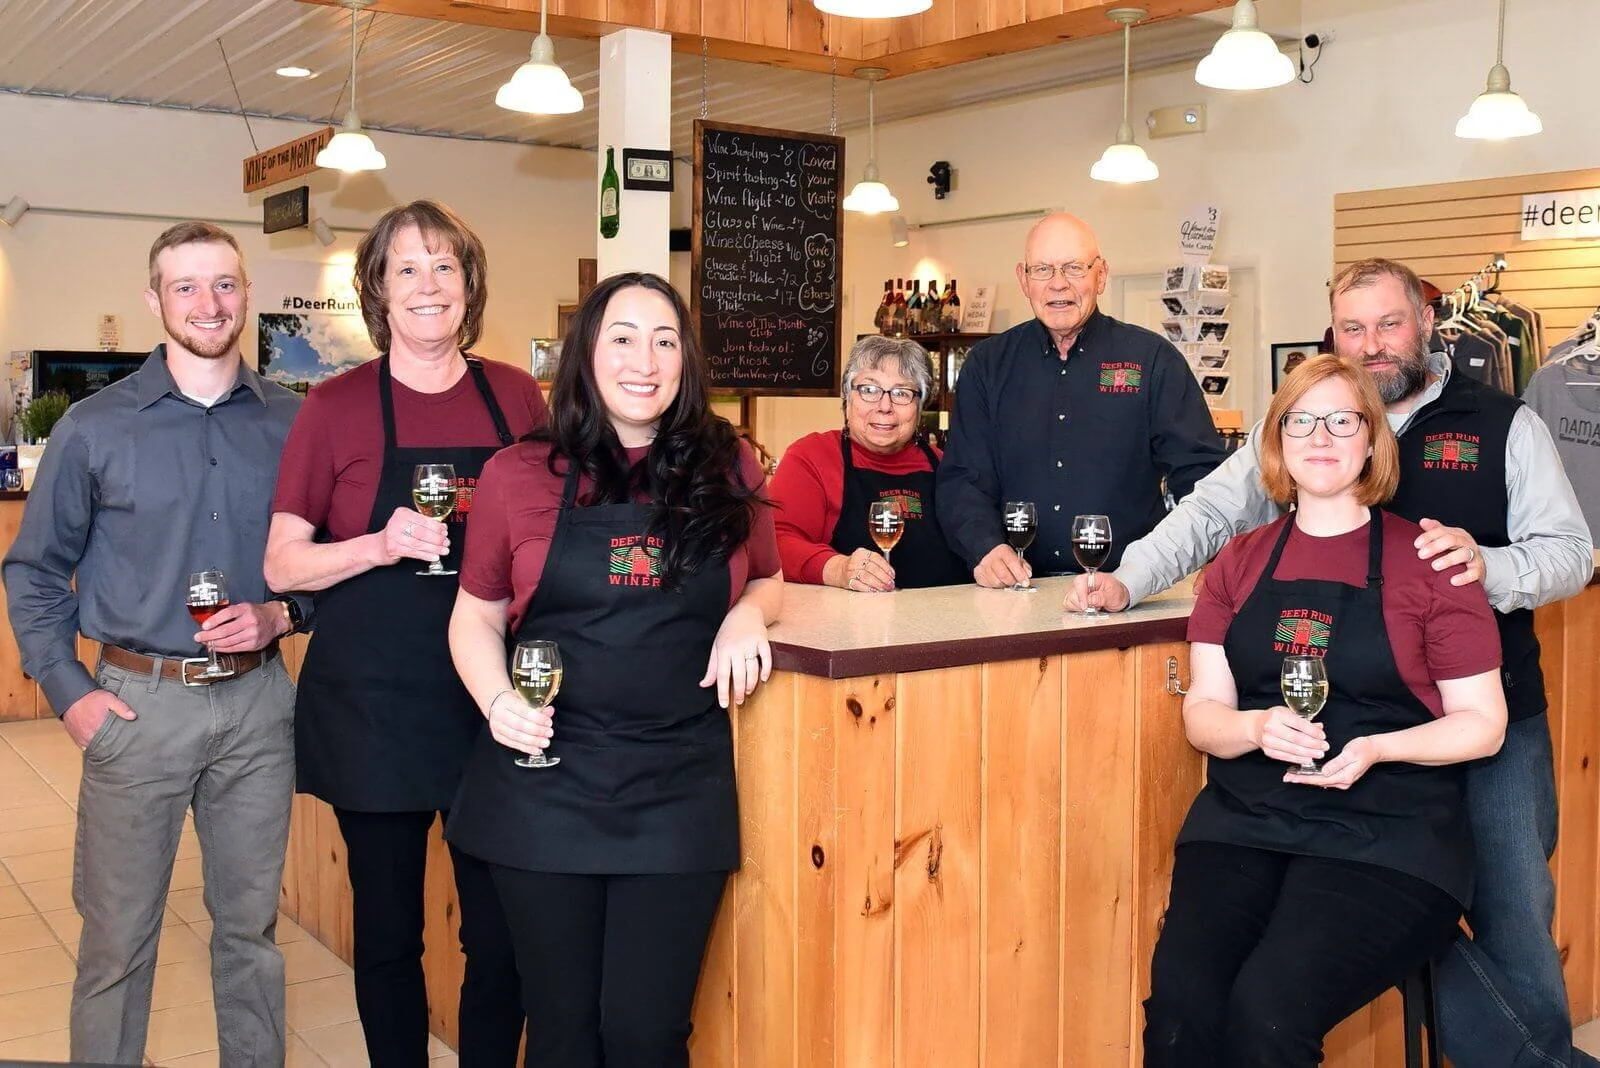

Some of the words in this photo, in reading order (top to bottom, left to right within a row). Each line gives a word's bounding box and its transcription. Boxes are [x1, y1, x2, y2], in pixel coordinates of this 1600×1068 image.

[277, 150, 290, 166] THE
[290, 134, 325, 173] MONTH
[704, 133, 729, 155] Wine
[732, 137, 768, 163] Sampling
[706, 162, 741, 183] Spirit
[706, 186, 738, 206] Wine
[705, 210, 742, 229] Glass
[744, 214, 758, 229] of
[761, 216, 785, 231] Wine
[704, 230, 734, 249] Wine
[743, 233, 785, 251] Cheese
[704, 257, 739, 271] Cheese
[749, 270, 776, 284] Plate
[1099, 386, 1141, 394] WINERY
[1425, 432, 1453, 443] DEER
[1455, 432, 1480, 443] RUN
[1423, 461, 1478, 471] WINERY
[647, 536, 664, 549] RU
[609, 575, 661, 587] WINER
[1281, 609, 1308, 618] DEER
[1311, 610, 1333, 624] RUN
[1274, 642, 1328, 657] WINERY
